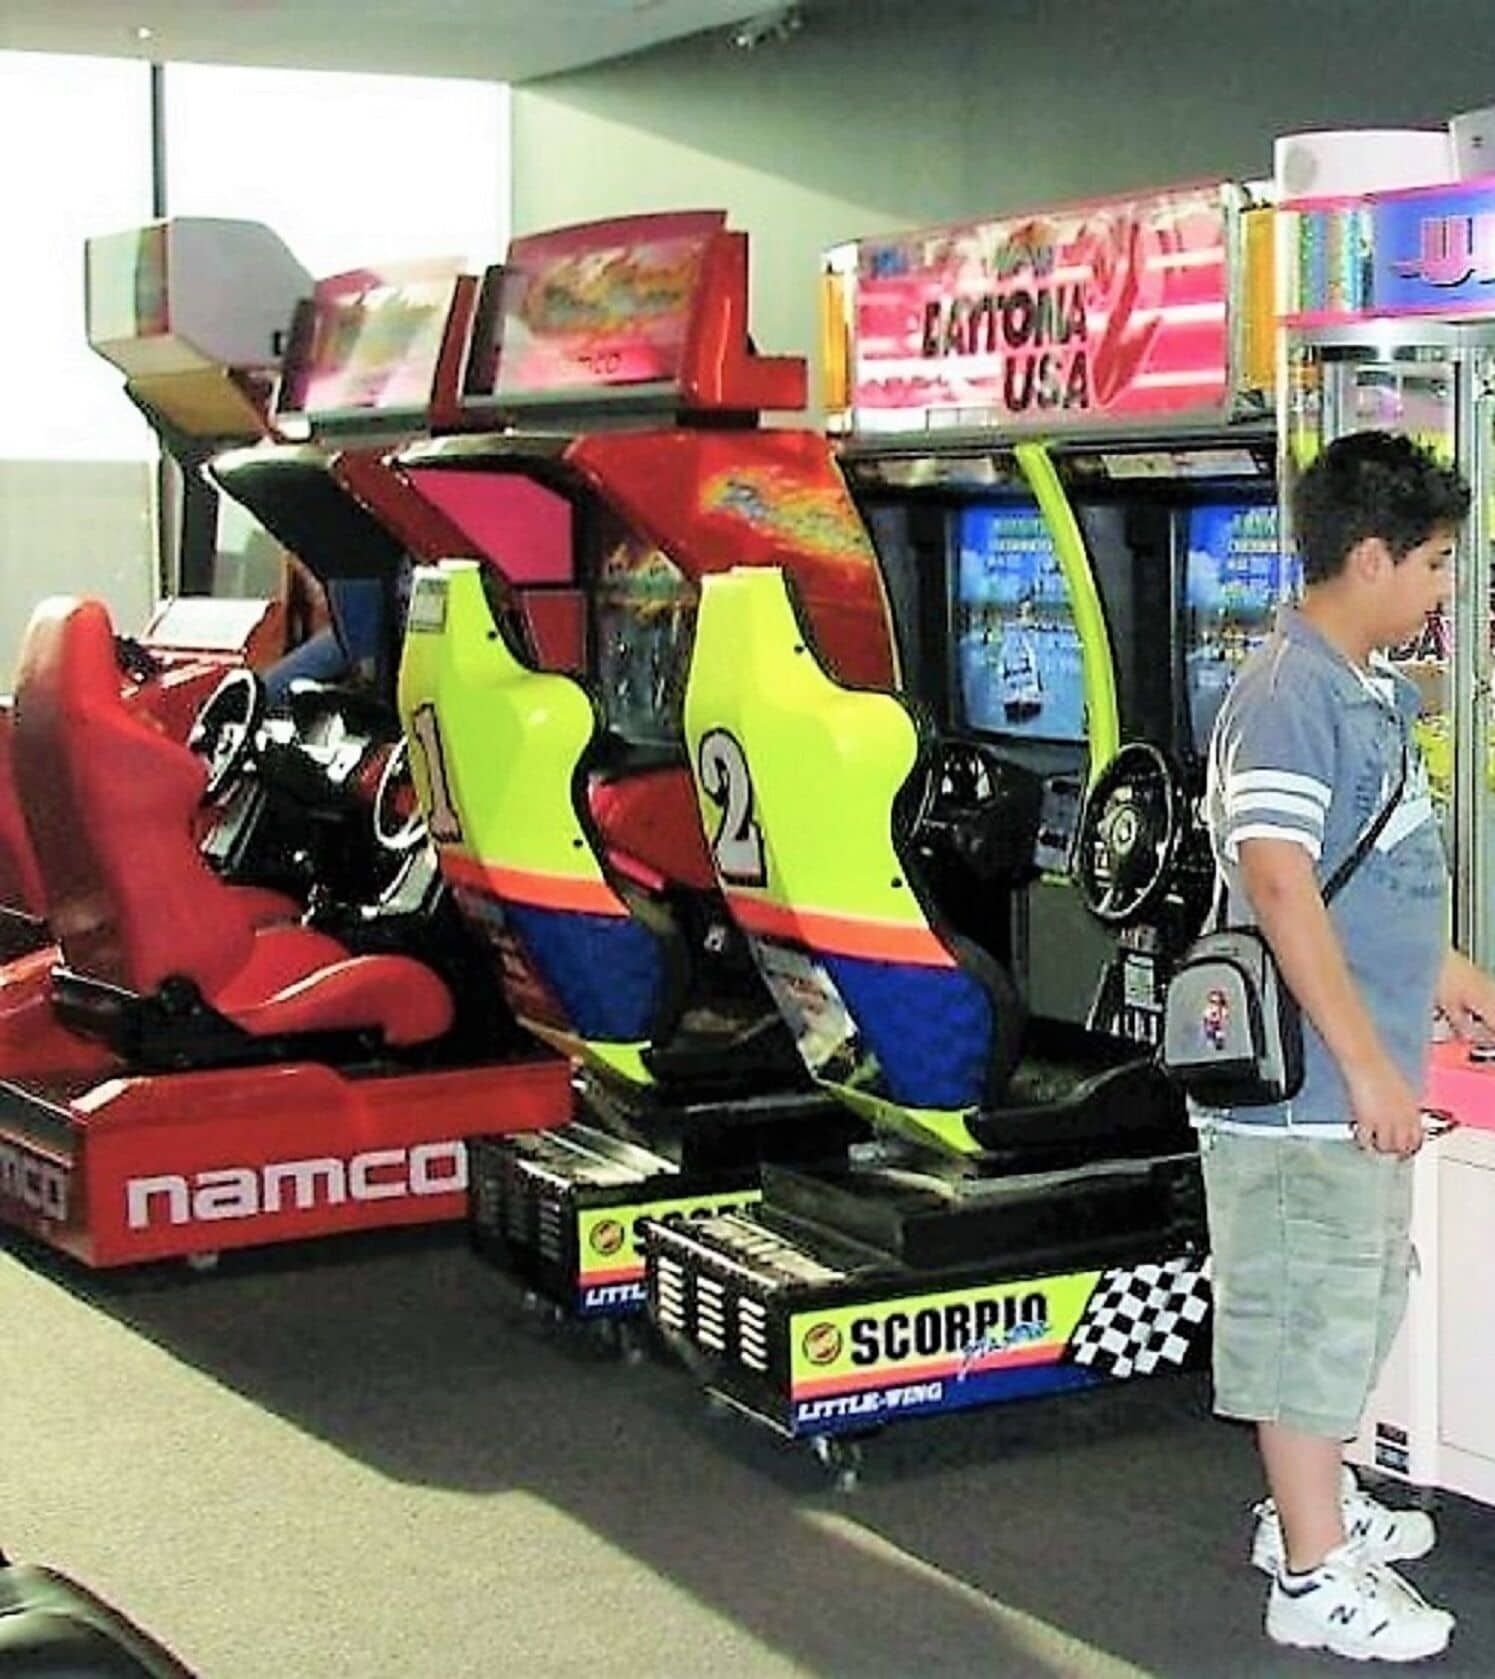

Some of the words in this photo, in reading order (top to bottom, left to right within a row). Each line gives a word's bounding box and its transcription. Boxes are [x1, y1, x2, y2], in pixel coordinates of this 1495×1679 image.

[921, 281, 1088, 358] DAYTONA
[1003, 349, 1090, 413] USA
[412, 702, 463, 843] 1
[700, 727, 769, 889] 2
[127, 1140, 469, 1228] namco
[850, 1291, 1048, 1366] SCORPIO
[798, 1381, 943, 1421] LITTLE-WING
[1328, 1605, 1358, 1625] N
